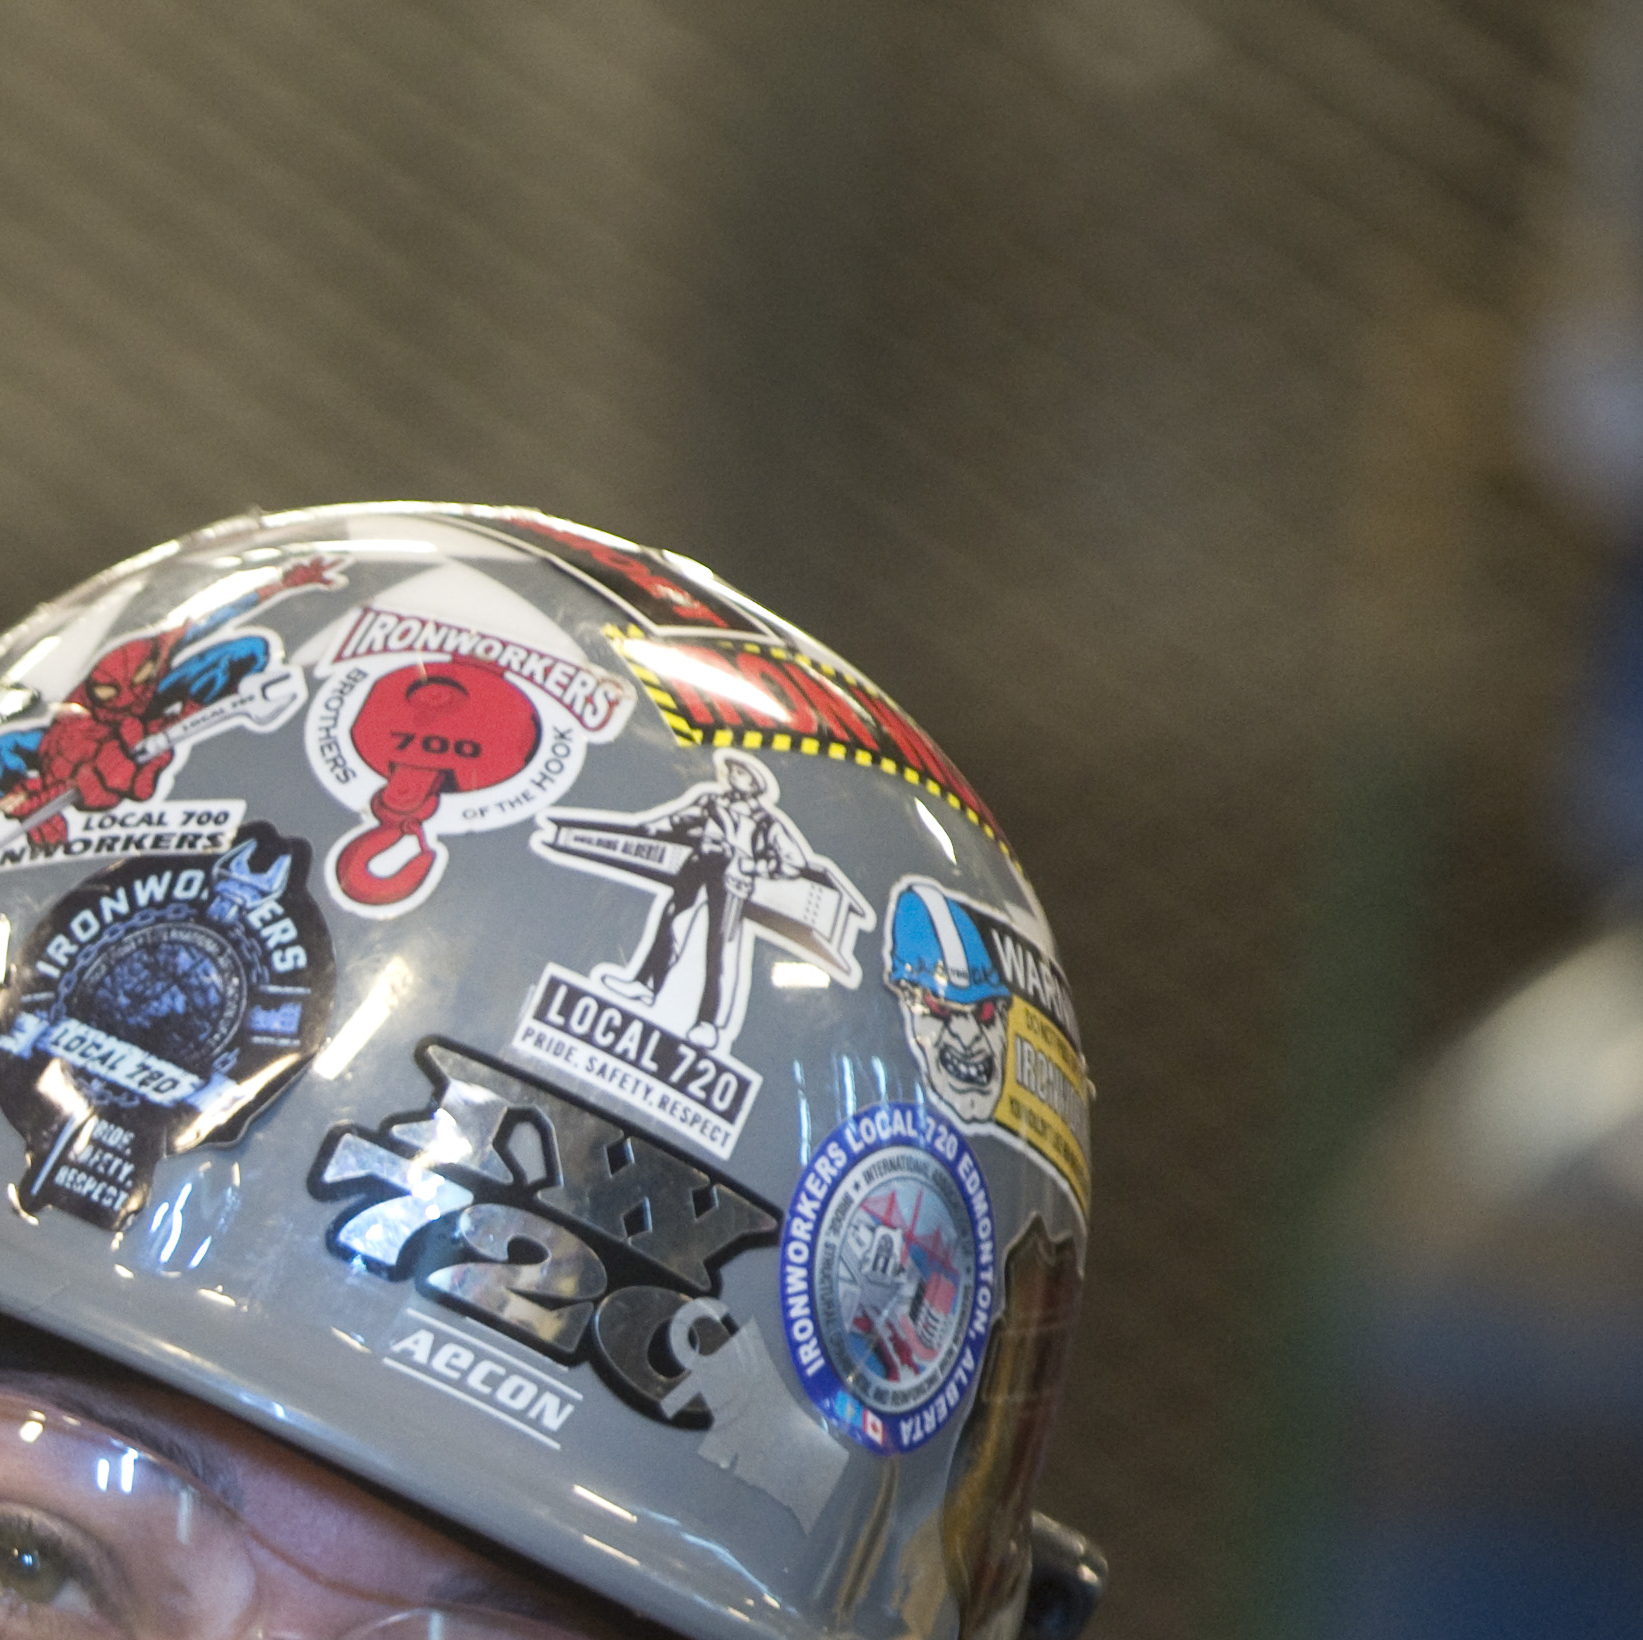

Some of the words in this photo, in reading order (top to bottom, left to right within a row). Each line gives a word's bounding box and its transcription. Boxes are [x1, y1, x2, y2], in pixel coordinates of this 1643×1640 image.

[342, 608, 615, 732] IRONWORKERS
[318, 667, 370, 785] BROTHERS
[462, 805, 491, 820] OF
[499, 789, 537, 815] THE
[531, 725, 574, 792] HOOK
[390, 731, 483, 759] 700
[82, 810, 170, 832] LOCAL
[182, 809, 230, 829] 700
[35, 867, 309, 979] IRONWOERS
[47, 1027, 119, 1076] LOCAL
[545, 982, 661, 1073] LOCAL
[669, 1042, 740, 1113] 720
[658, 1094, 733, 1149] RESPECT
[785, 1141, 848, 1377] IRONWORKERS
[845, 1109, 918, 1151] LOCAL
[900, 1347, 975, 1448] ALBERTA
